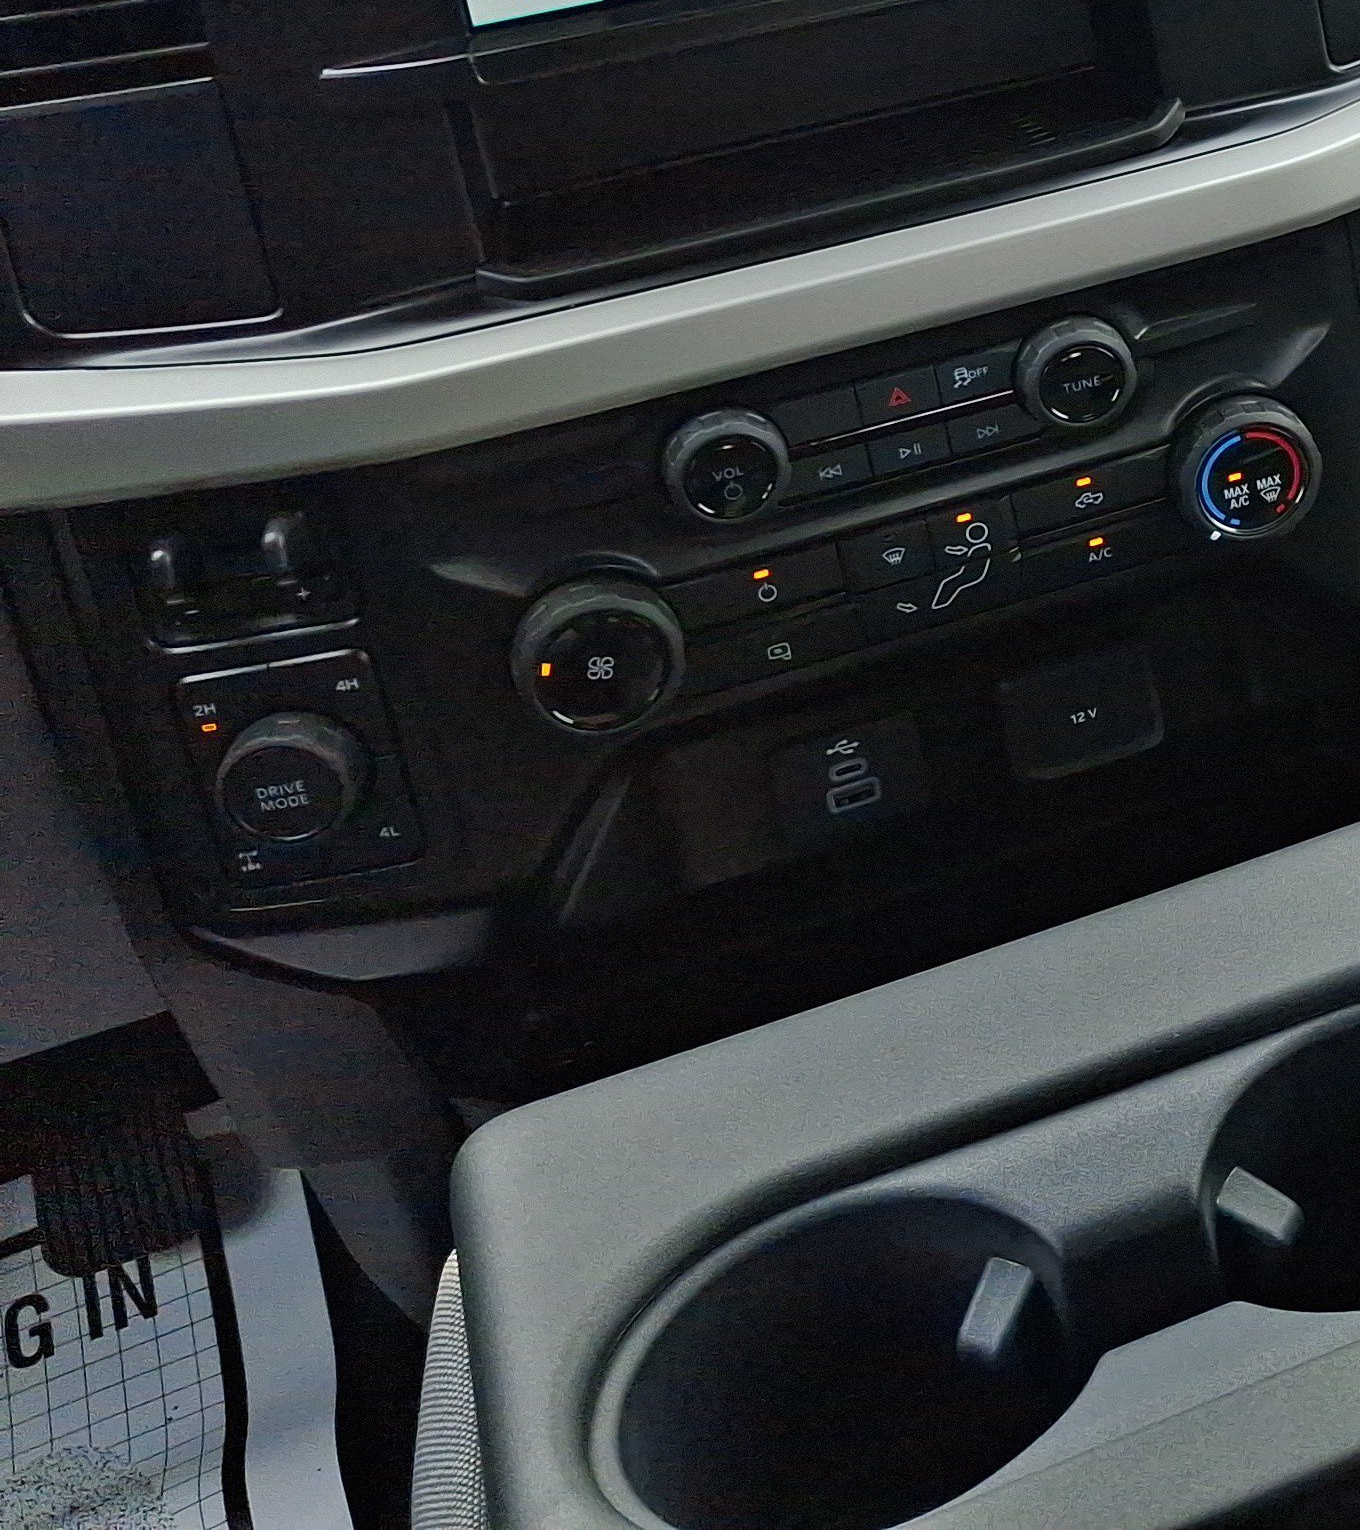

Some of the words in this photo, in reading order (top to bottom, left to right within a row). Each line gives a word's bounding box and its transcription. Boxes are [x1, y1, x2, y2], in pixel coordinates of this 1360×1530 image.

[968, 366, 988, 380] OFF
[1063, 375, 1101, 395] TUNE
[711, 466, 744, 482] VOL
[1256, 474, 1281, 490] MAX
[1224, 484, 1250, 500] MAX
[1230, 495, 1250, 509] A/C
[1088, 547, 1113, 562] A/C
[335, 678, 359, 692] 4H
[193, 703, 216, 717] 2H
[256, 780, 305, 800] DRIVE
[260, 794, 309, 812] MODE
[379, 826, 400, 838] 4L
[82, 1257, 158, 1340] IN
